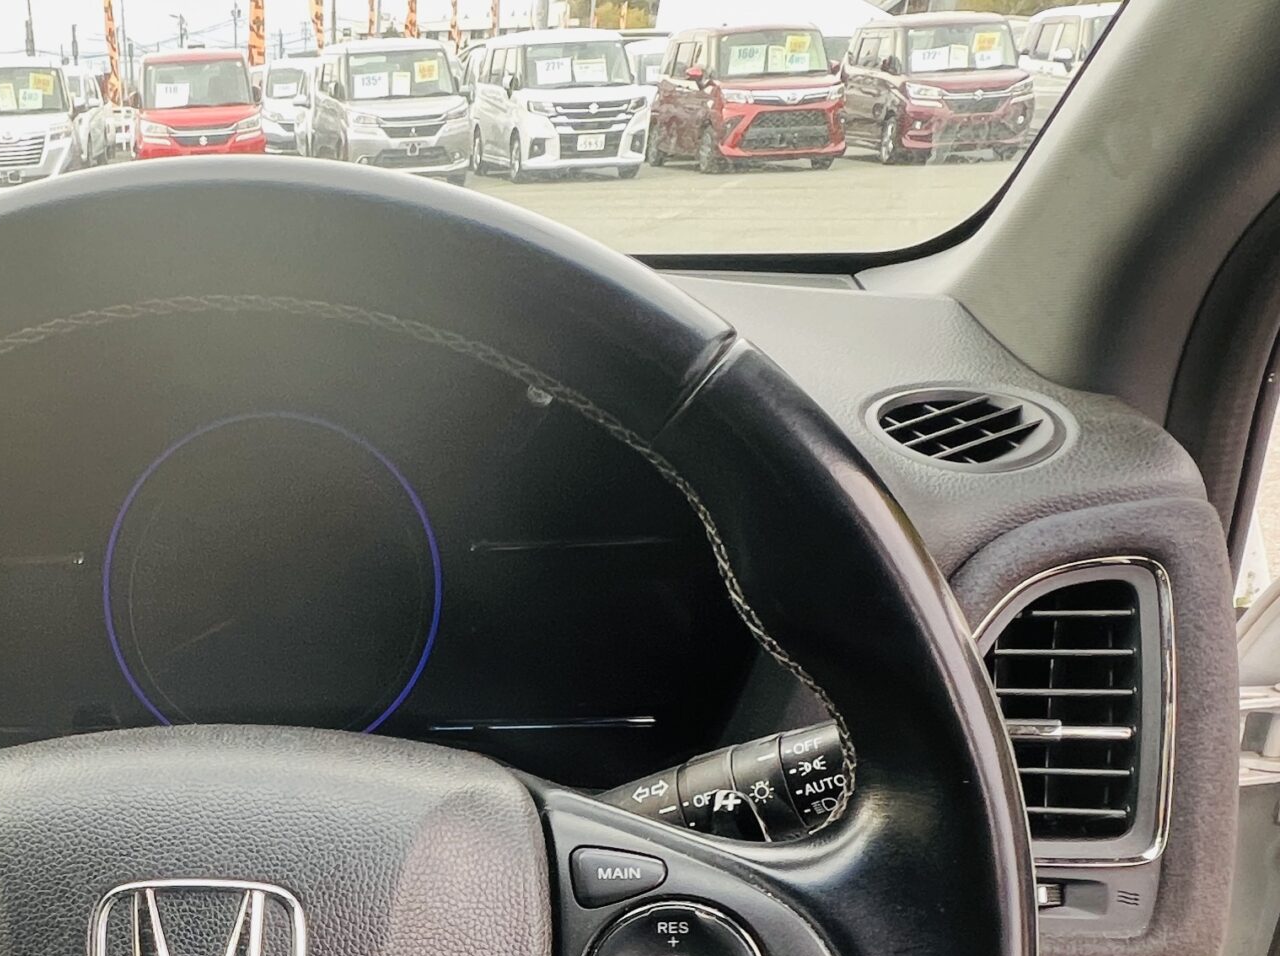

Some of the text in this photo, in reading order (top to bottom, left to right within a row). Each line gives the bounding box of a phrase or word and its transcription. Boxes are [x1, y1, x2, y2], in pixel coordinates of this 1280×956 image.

[793, 737, 823, 755] OFF
[805, 773, 847, 796] AUTO
[597, 867, 641, 880] MAIN
[657, 921, 689, 934] RES
